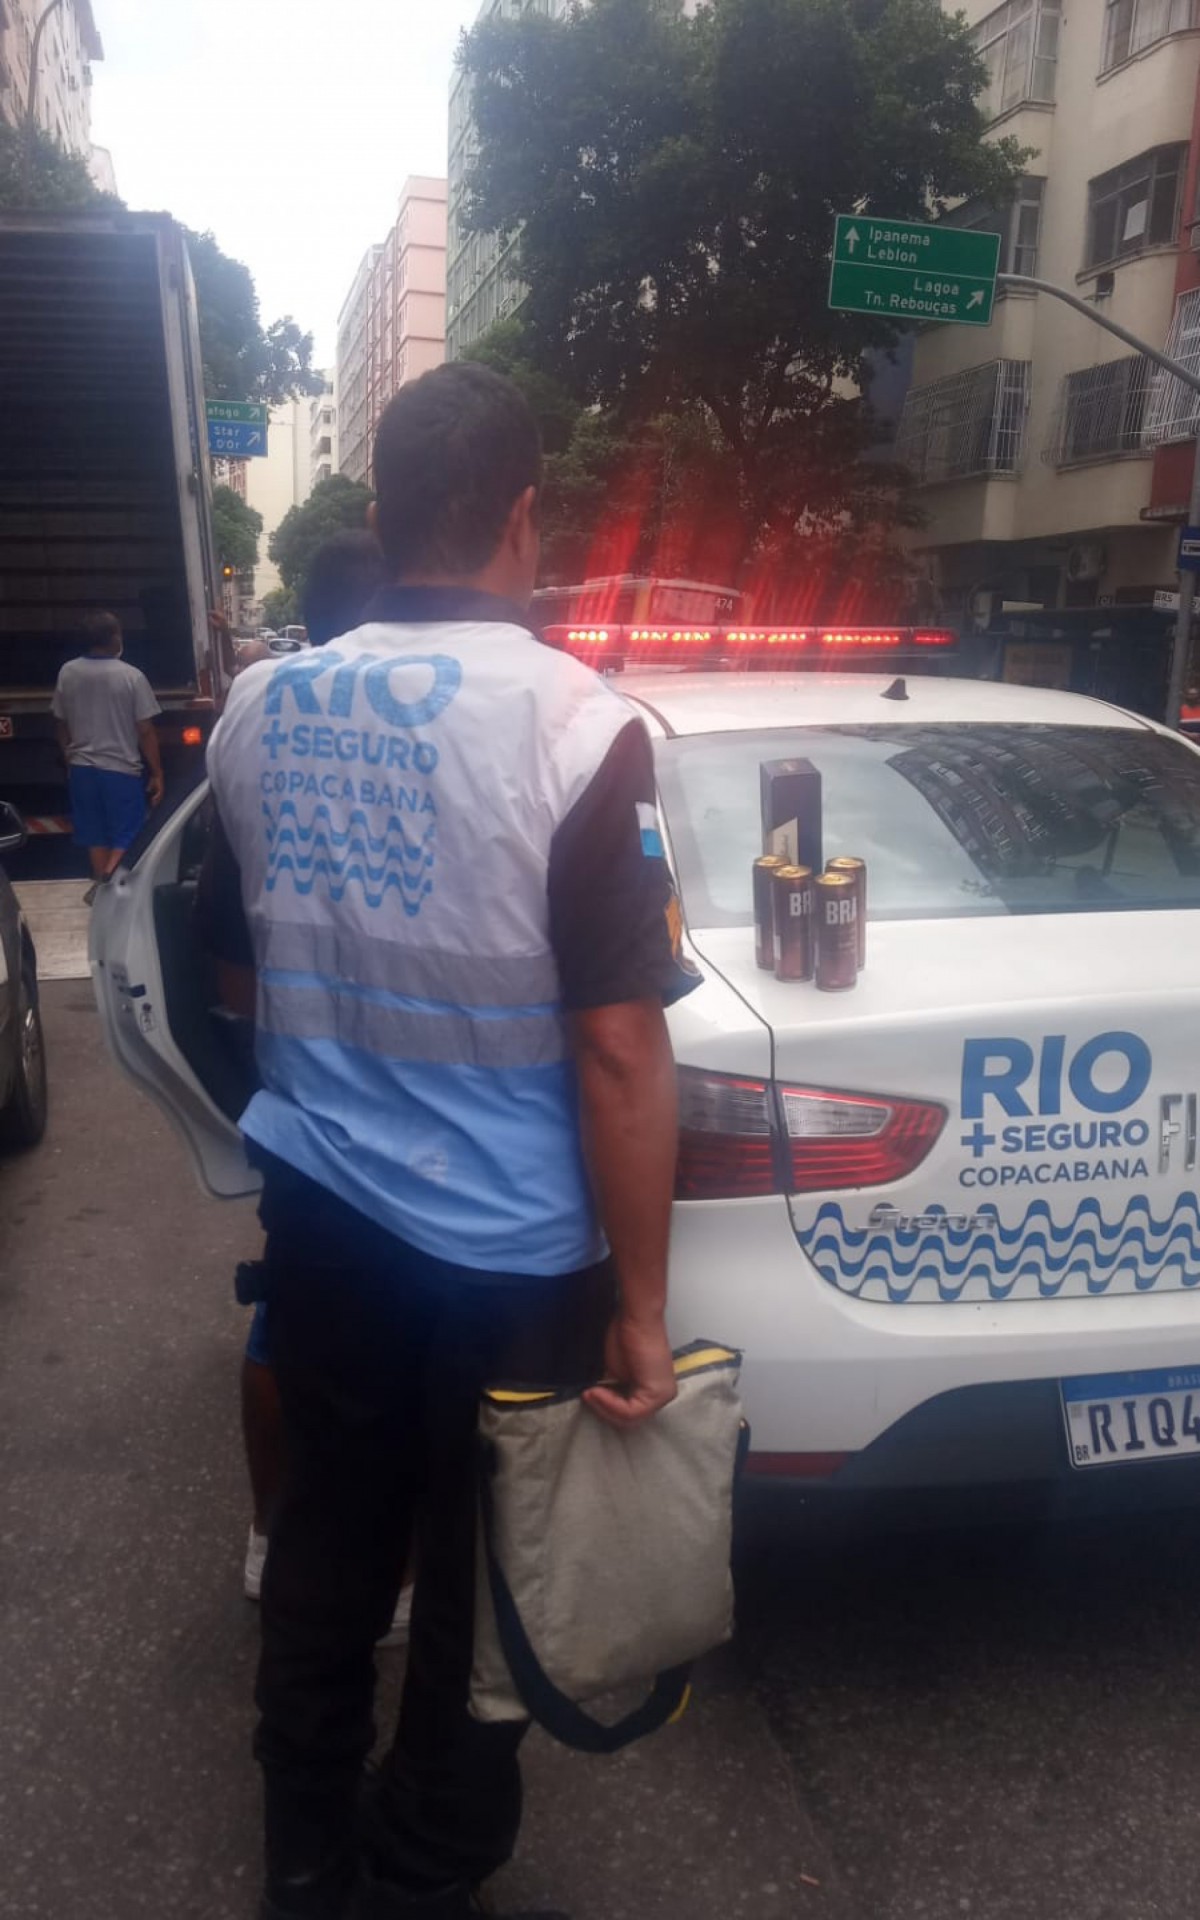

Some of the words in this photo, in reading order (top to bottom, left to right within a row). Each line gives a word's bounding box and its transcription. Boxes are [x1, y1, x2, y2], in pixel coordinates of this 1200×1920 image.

[869, 226, 930, 246] Ipanema
[867, 244, 917, 264] Leblon
[913, 277, 960, 296] Lagoa
[864, 290, 884, 307] Tn.
[889, 293, 957, 315] Rebouças
[264, 650, 462, 728] RIO
[260, 771, 437, 817] COPACABANA
[960, 1031, 1152, 1119] RIO
[959, 1157, 1149, 1188] COPACABANA
[1088, 1394, 1200, 1454] RIQ4
